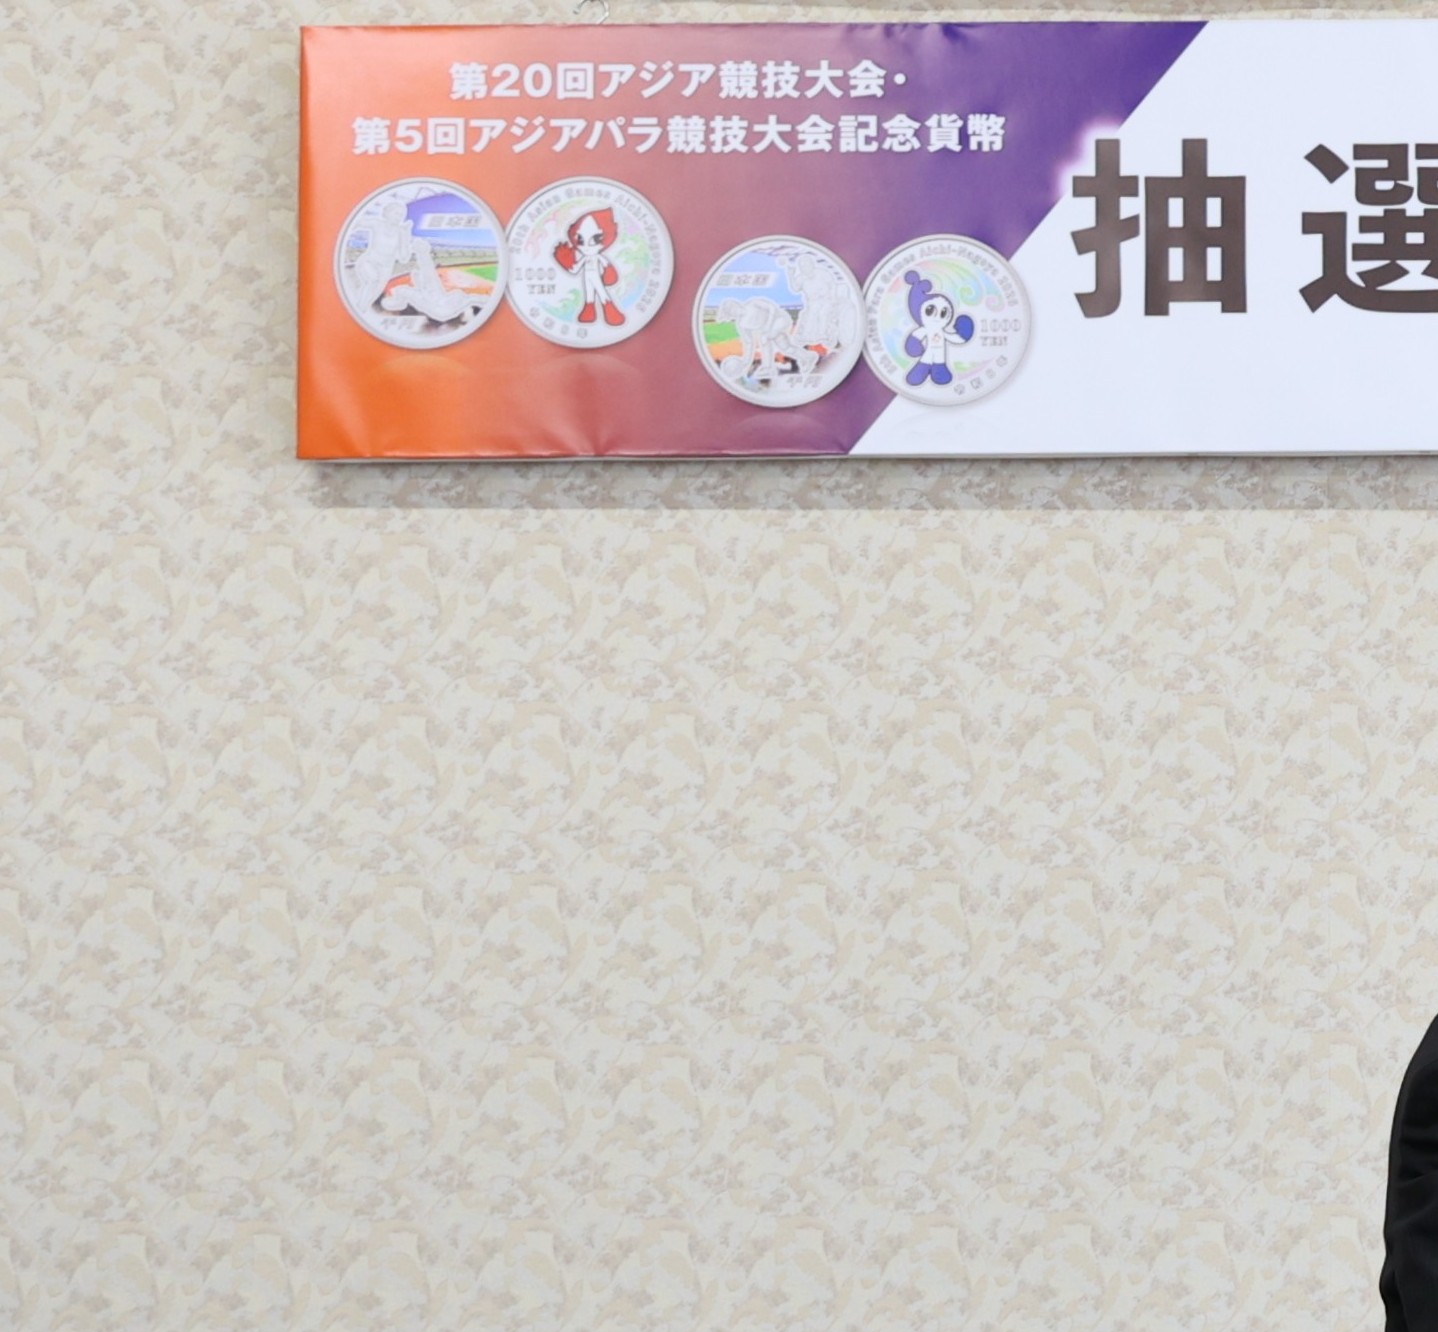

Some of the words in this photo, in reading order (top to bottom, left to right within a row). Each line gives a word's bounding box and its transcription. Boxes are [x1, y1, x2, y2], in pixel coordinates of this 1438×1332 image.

[352, 113, 1006, 155] 第5回アジアパラ競技大会記念貨幣
[980, 318, 1021, 333] 1000
